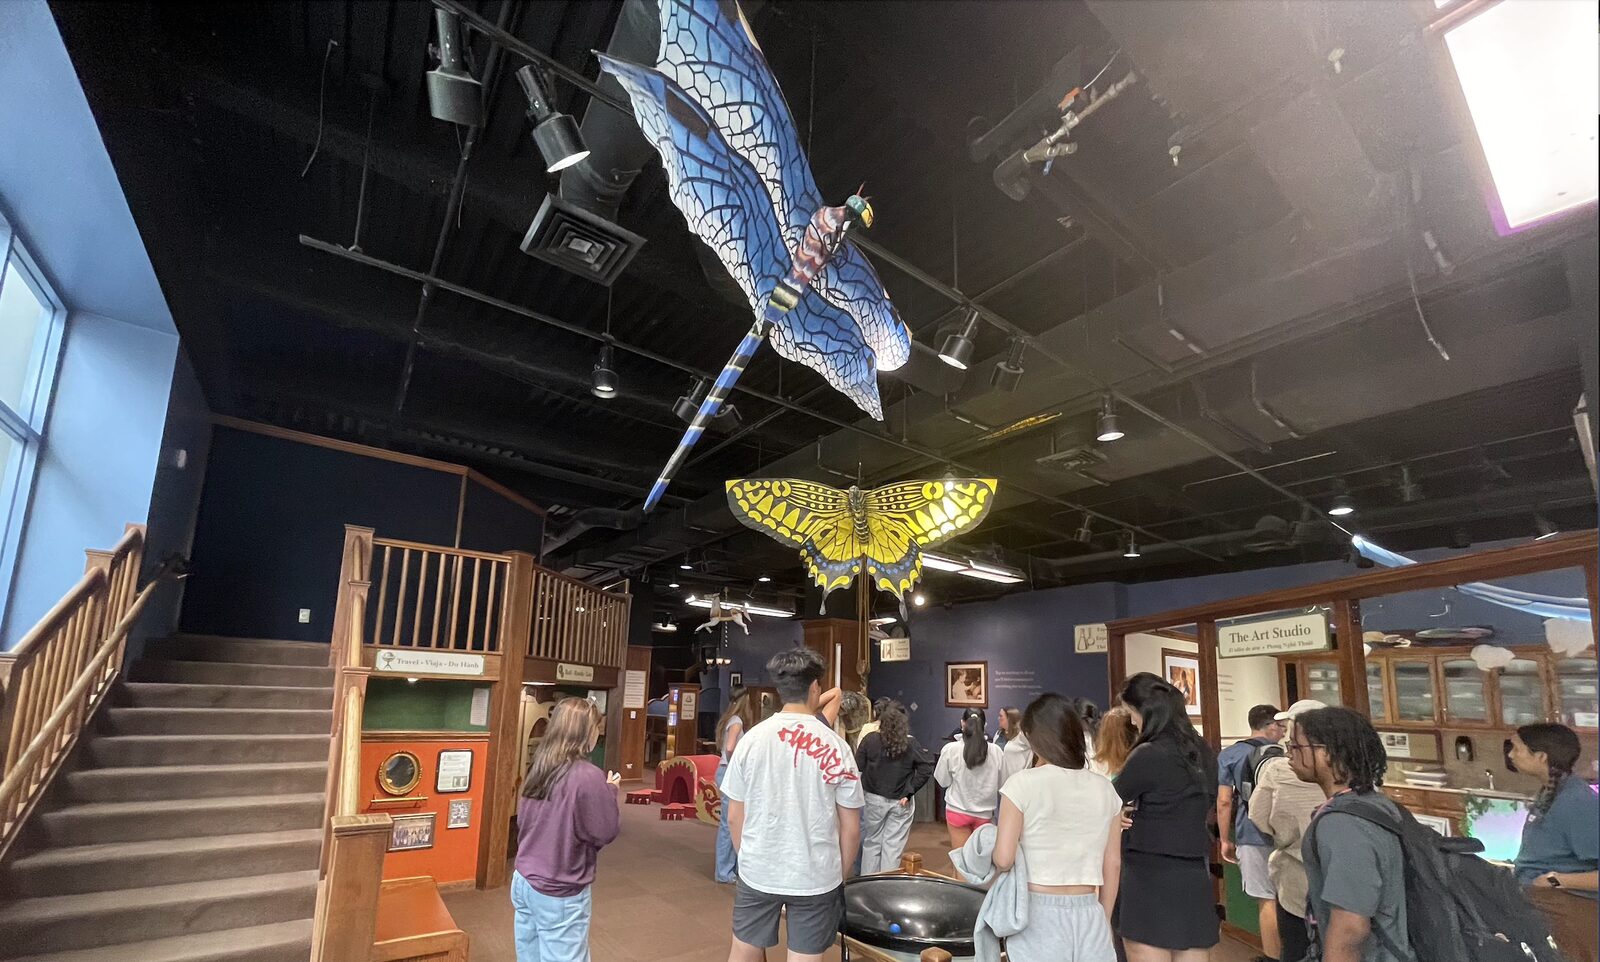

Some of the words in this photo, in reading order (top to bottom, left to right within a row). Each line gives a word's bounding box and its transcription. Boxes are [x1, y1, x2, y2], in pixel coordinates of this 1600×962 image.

[1229, 632, 1249, 643] The
[1252, 630, 1269, 642] Art
[1273, 624, 1311, 639] Studio
[425, 659, 443, 668] Viaja
